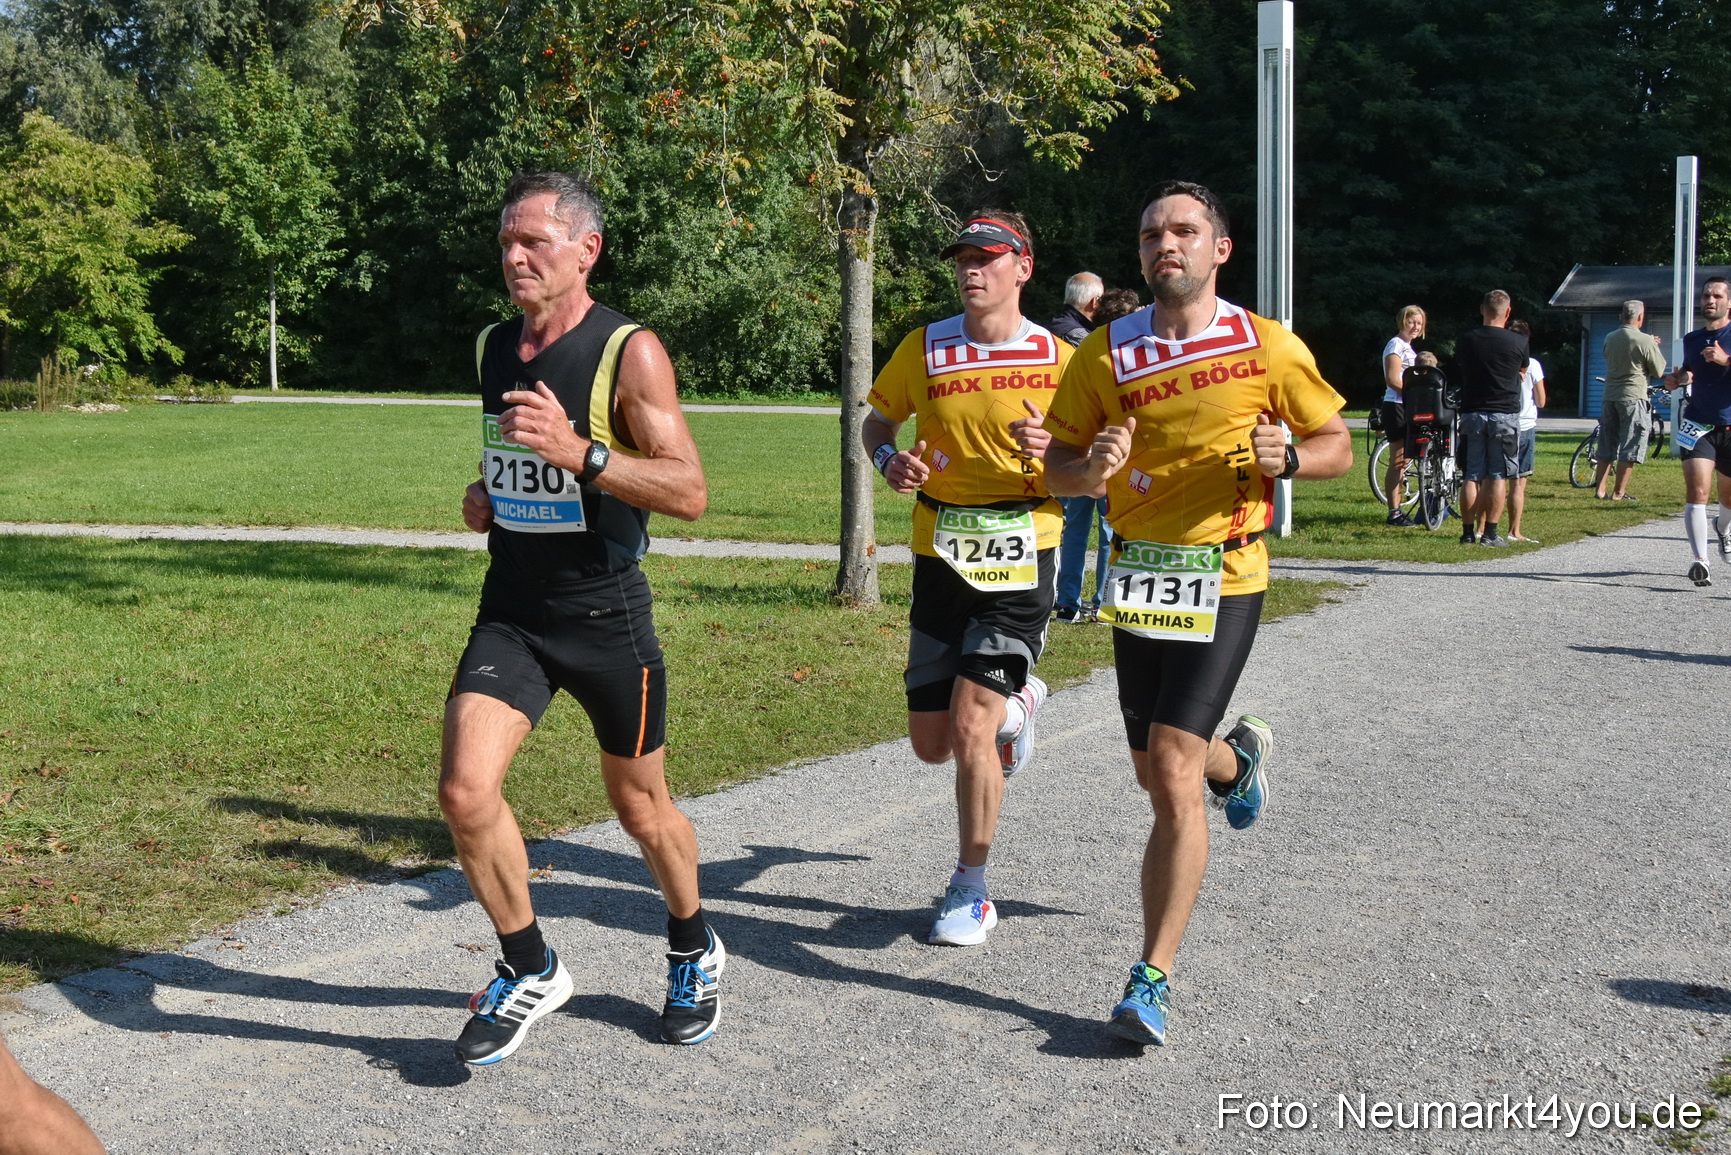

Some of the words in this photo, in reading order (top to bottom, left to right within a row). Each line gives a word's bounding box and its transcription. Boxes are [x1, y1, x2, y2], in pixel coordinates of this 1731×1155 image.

[927, 376, 983, 401] MAX
[991, 370, 1058, 391] BÖGL
[1119, 377, 1183, 413] MAX
[1190, 358, 1267, 391] BÖGL
[491, 456, 565, 495] 2130
[496, 501, 562, 520] MICHAEL
[942, 510, 1024, 532] BOCK
[947, 536, 1025, 563] 1243
[1118, 544, 1214, 570] BOCK
[959, 570, 1010, 582] SIMON
[1118, 575, 1203, 607] 1131
[1115, 611, 1195, 629] MATHIAS
